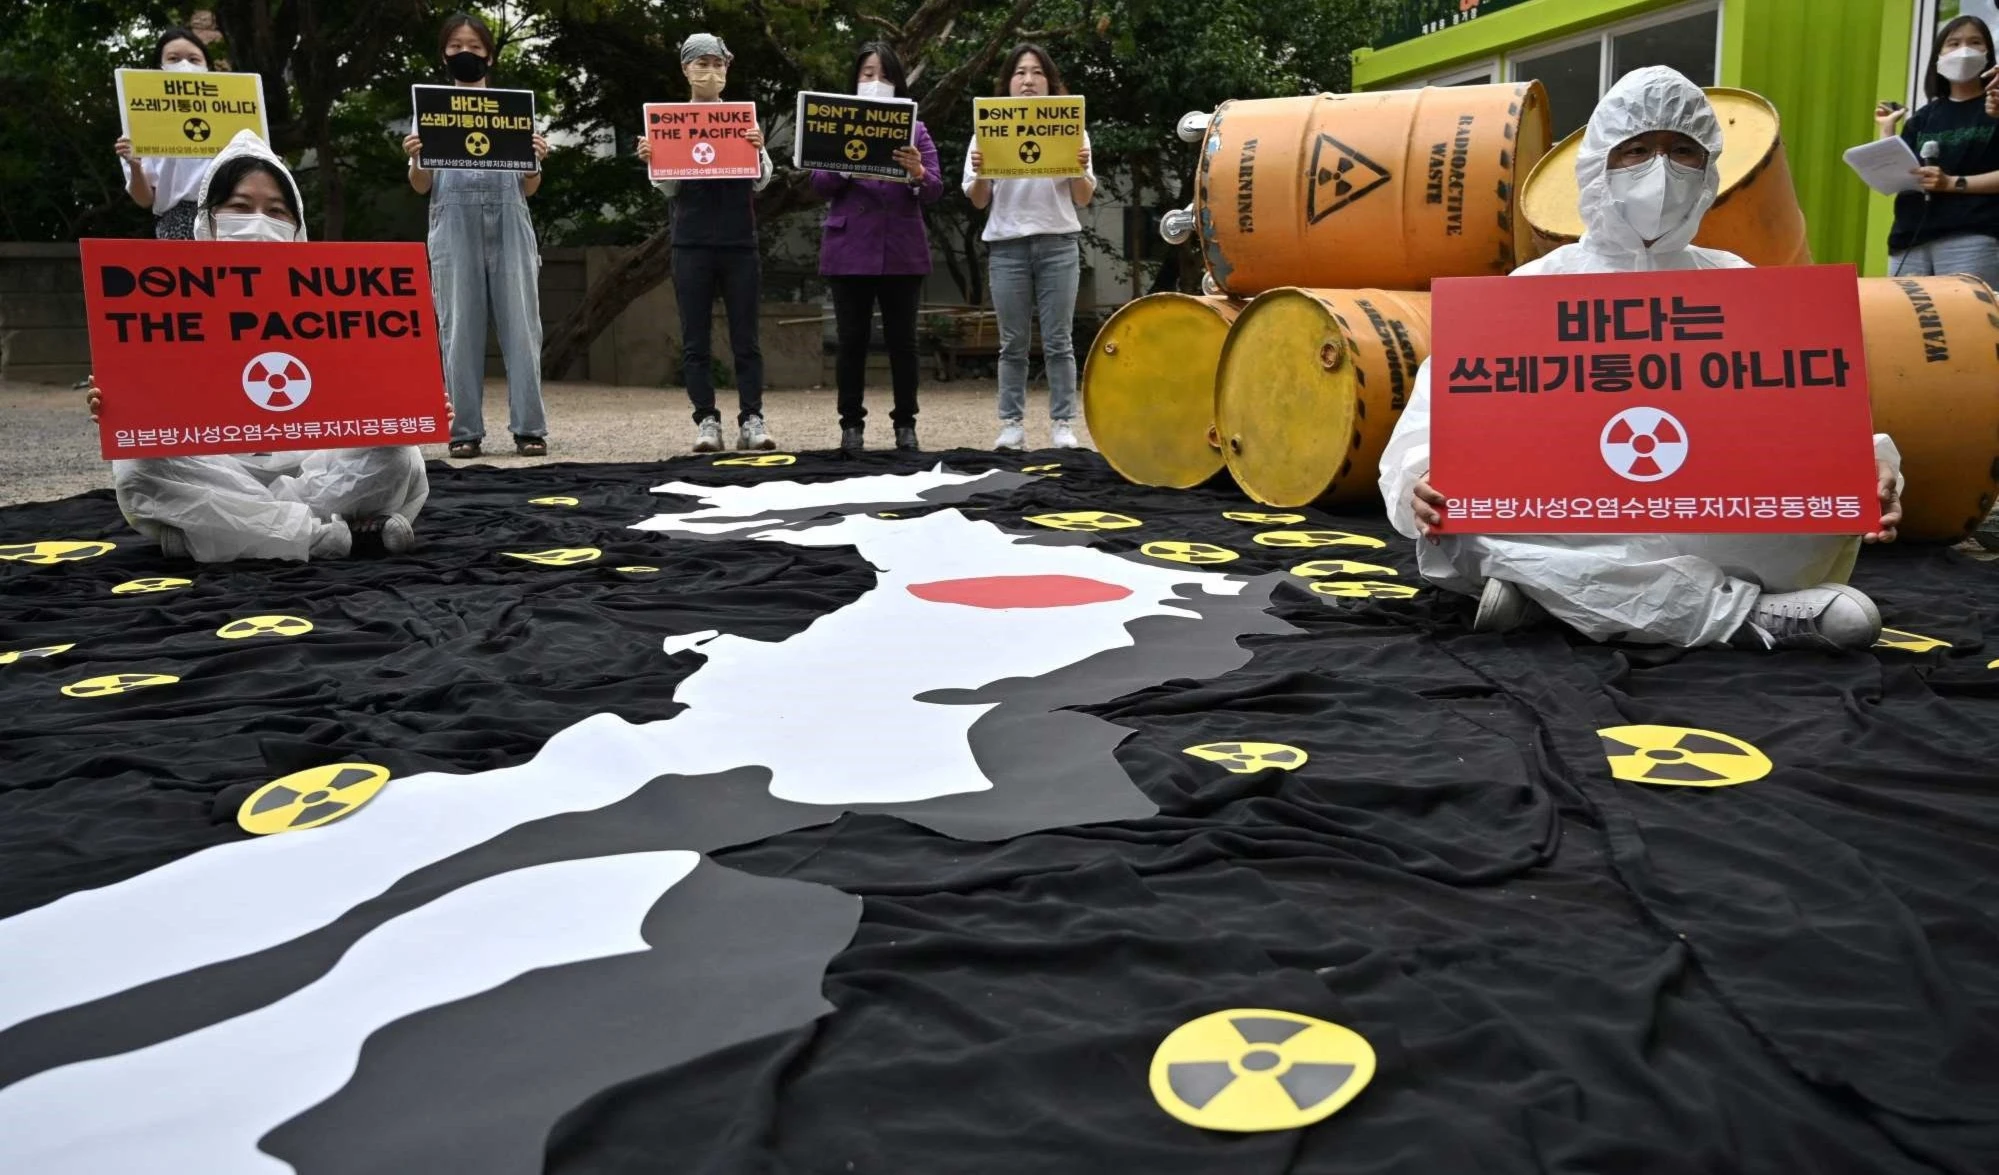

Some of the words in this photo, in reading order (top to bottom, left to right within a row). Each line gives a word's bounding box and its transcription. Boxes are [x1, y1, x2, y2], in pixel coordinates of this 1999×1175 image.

[164, 79, 219, 97] 바다는
[130, 98, 207, 113] 쓰레기통이
[212, 100, 257, 115] 아니다
[450, 95, 500, 114] 바다는
[807, 103, 859, 120] DON'T
[865, 109, 911, 125] NUKE
[978, 107, 1029, 121] DON'T
[1036, 106, 1080, 120] NUKE
[420, 112, 488, 129] 쓰레기통이
[491, 115, 532, 131] 아니다
[650, 112, 700, 125] DON'T
[708, 111, 752, 124] NUKE
[651, 128, 682, 140] THE
[807, 120, 838, 134] THE
[843, 123, 909, 140] PACIFIC!
[979, 125, 1009, 138] THE
[1016, 124, 1080, 137] PACIFIC!
[1425, 142, 1448, 204] WASTE
[1446, 115, 1475, 237] RADIOACTIVE
[1237, 138, 1259, 234] WARNING!
[100, 265, 262, 299] DON'T
[288, 265, 417, 298] NUKE
[106, 311, 205, 343] THE
[229, 310, 422, 341] PACIFIC!
[1556, 296, 1725, 343] 바다는
[1448, 352, 1682, 394] 쓰레기통이
[1699, 348, 1851, 390] 아니다
[115, 415, 437, 448] 일본방사성오염수방류저지공동행동
[1445, 495, 1862, 520] 일본방사성오염수방류저지공동행동
